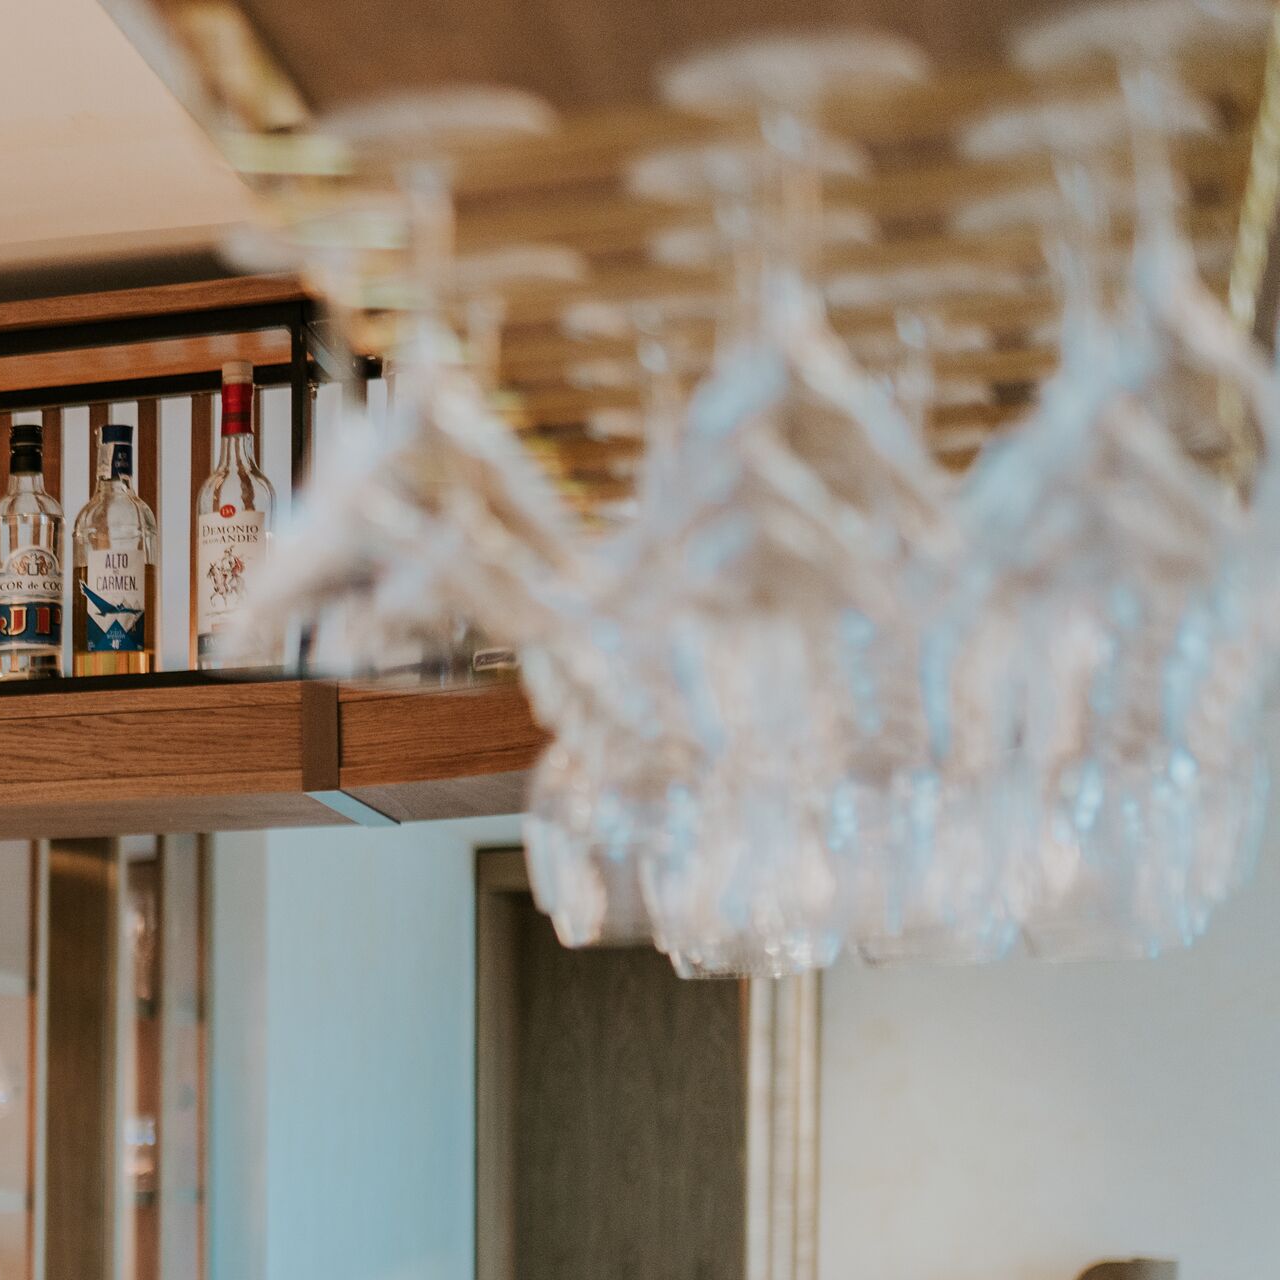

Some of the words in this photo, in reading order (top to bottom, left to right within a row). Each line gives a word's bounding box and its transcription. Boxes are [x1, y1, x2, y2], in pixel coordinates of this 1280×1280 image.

[202, 524, 259, 538] DEMONIO
[220, 534, 258, 544] ANDES
[105, 553, 128, 569] ALTO
[43, 581, 62, 591] COC
